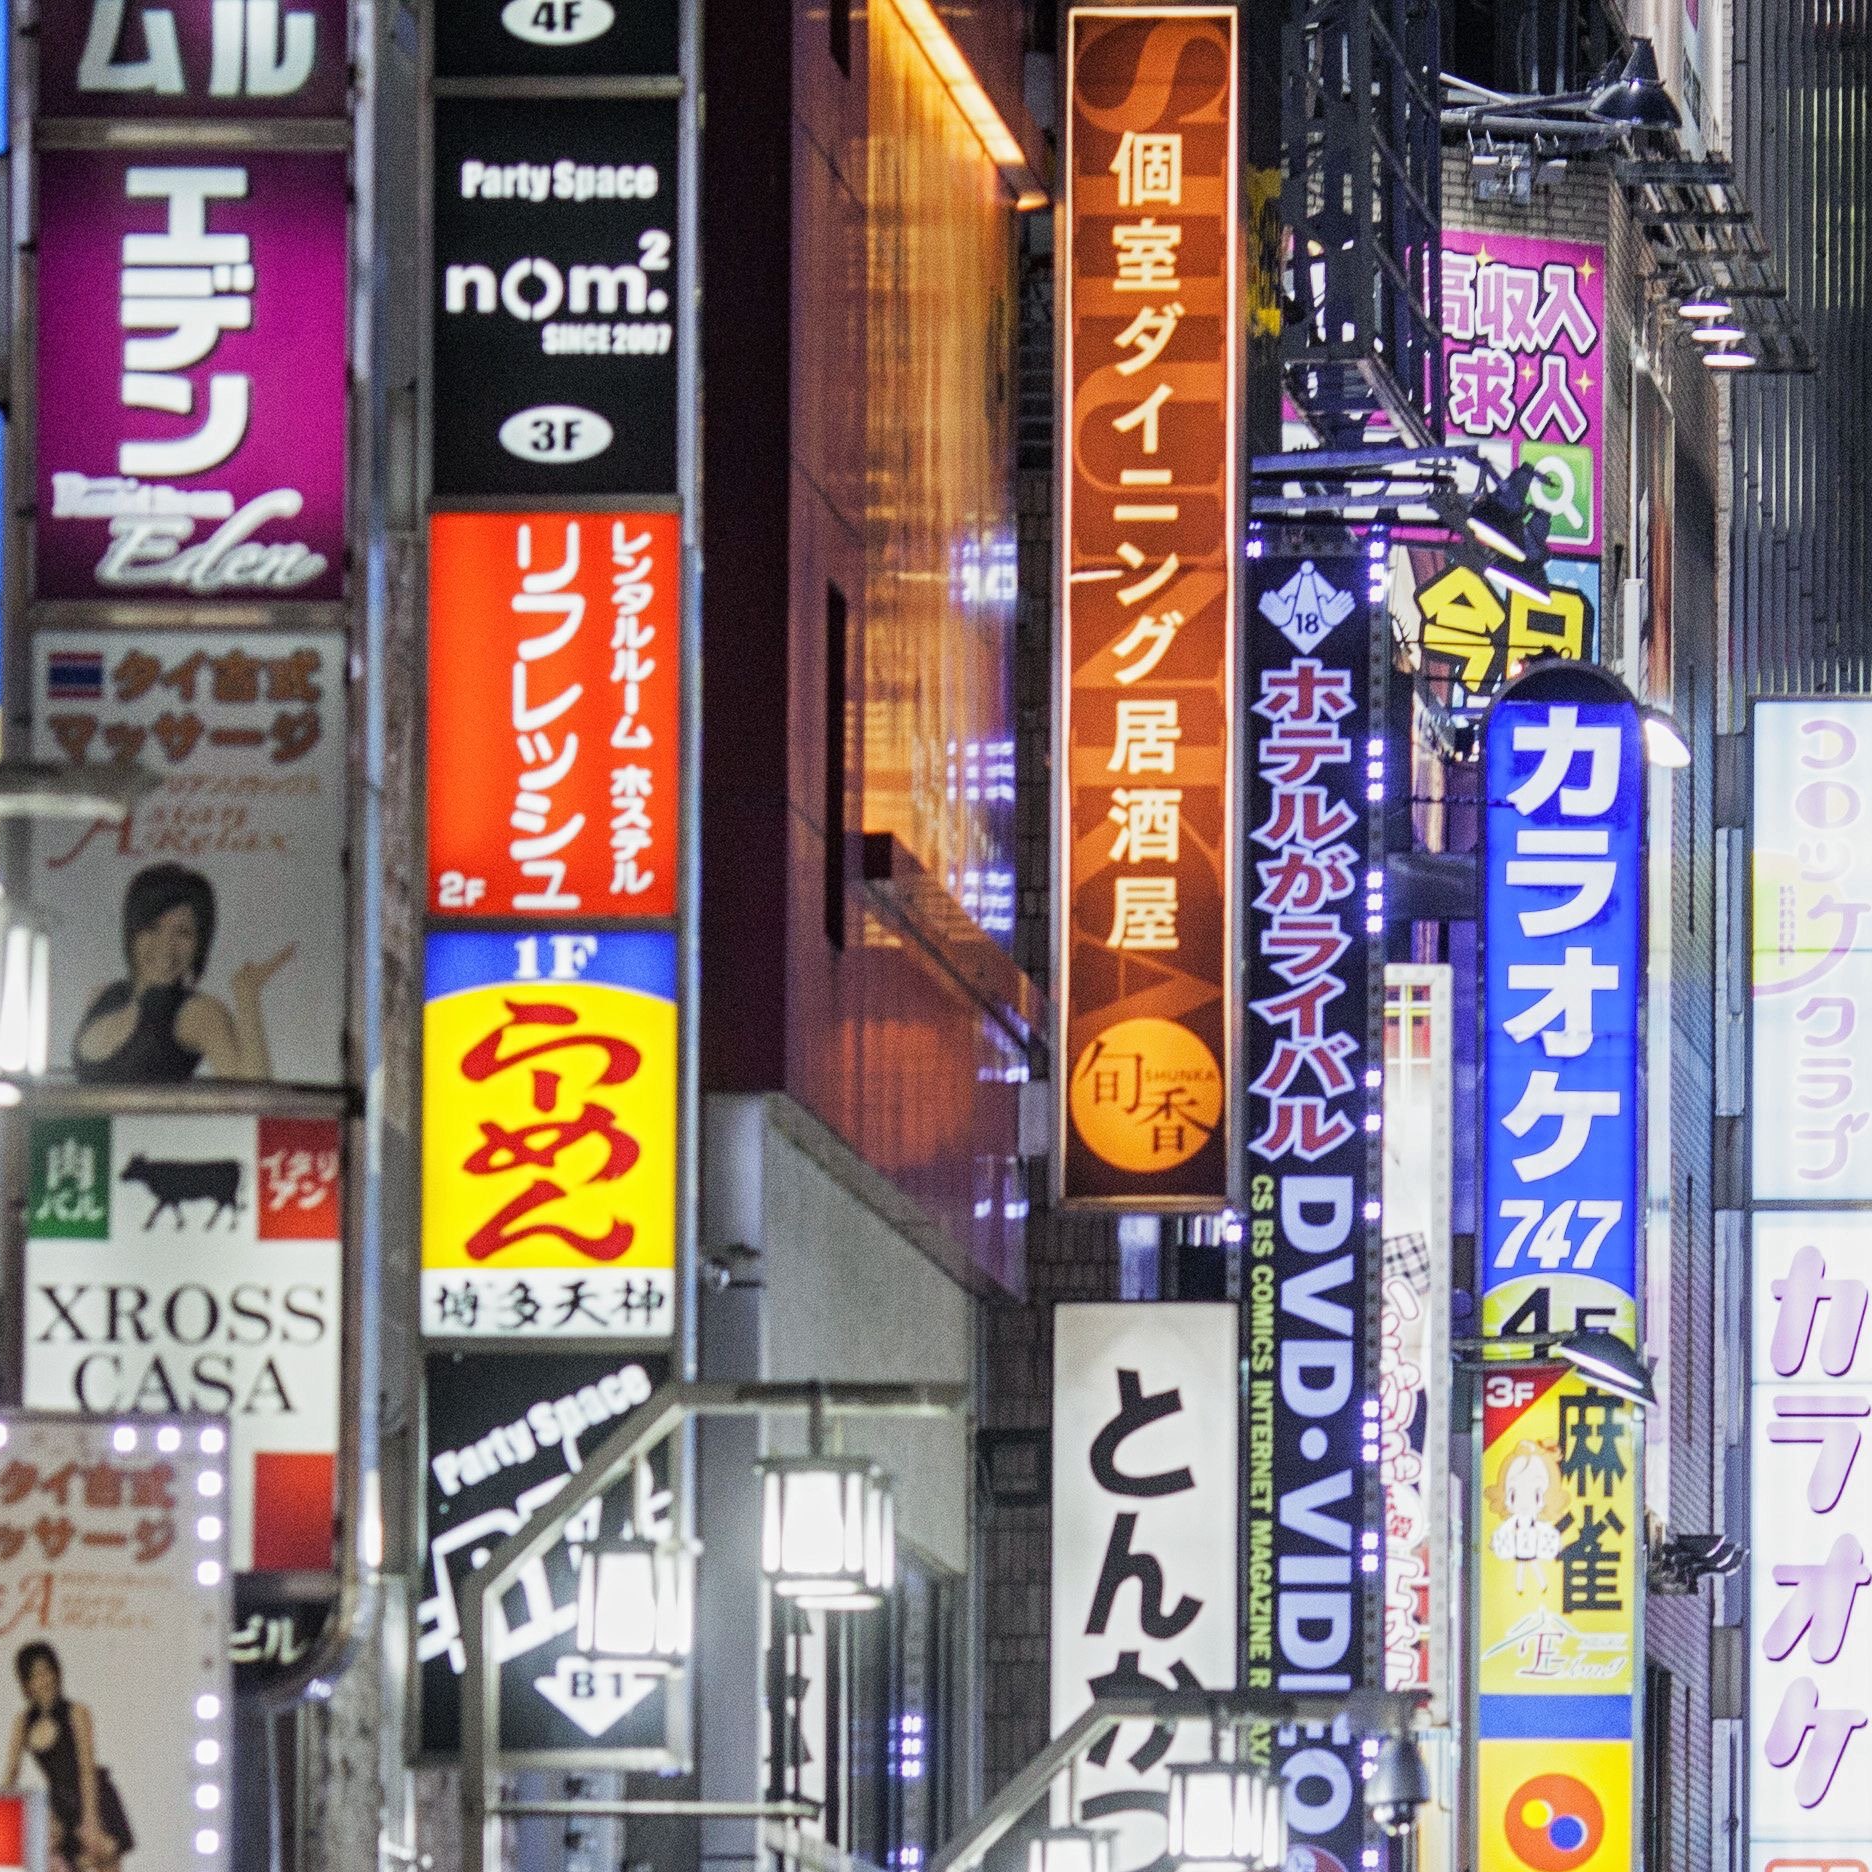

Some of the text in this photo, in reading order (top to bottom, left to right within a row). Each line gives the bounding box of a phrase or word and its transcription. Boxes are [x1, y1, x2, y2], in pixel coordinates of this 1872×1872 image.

[460, 161, 659, 201] Party Space
[118, 166, 254, 479] エデン
[542, 324, 672, 355] SINCE 2007
[528, 418, 583, 453] 3F
[1450, 348, 1591, 449] 求人
[99, 488, 330, 596] Eden
[1107, 131, 1185, 951] 個室ダイニング居酒屋
[1293, 611, 1320, 635] 18
[510, 521, 587, 910] リフレッシュ
[609, 523, 655, 897] レンタルルーム ホステル
[438, 871, 485, 908] 2F
[1248, 658, 1359, 1163] ホテルがライバル
[511, 936, 596, 980] 1F
[1501, 705, 1622, 1187] カラオケ
[459, 999, 643, 1262] らーめん
[1493, 1199, 1623, 1270] 747
[36, 1285, 326, 1346] XROSS
[433, 1279, 667, 1330] 博多天神
[73, 1353, 295, 1414] CASA
[1249, 1174, 1275, 1662] CS BS COMICS INTERNET MAGAZINE
[1485, 1377, 1535, 1407] 3F
[432, 1419, 538, 1496] Party
[1560, 1386, 1628, 1615] 麻雀
[1763, 1246, 1872, 1809] カラオケ
